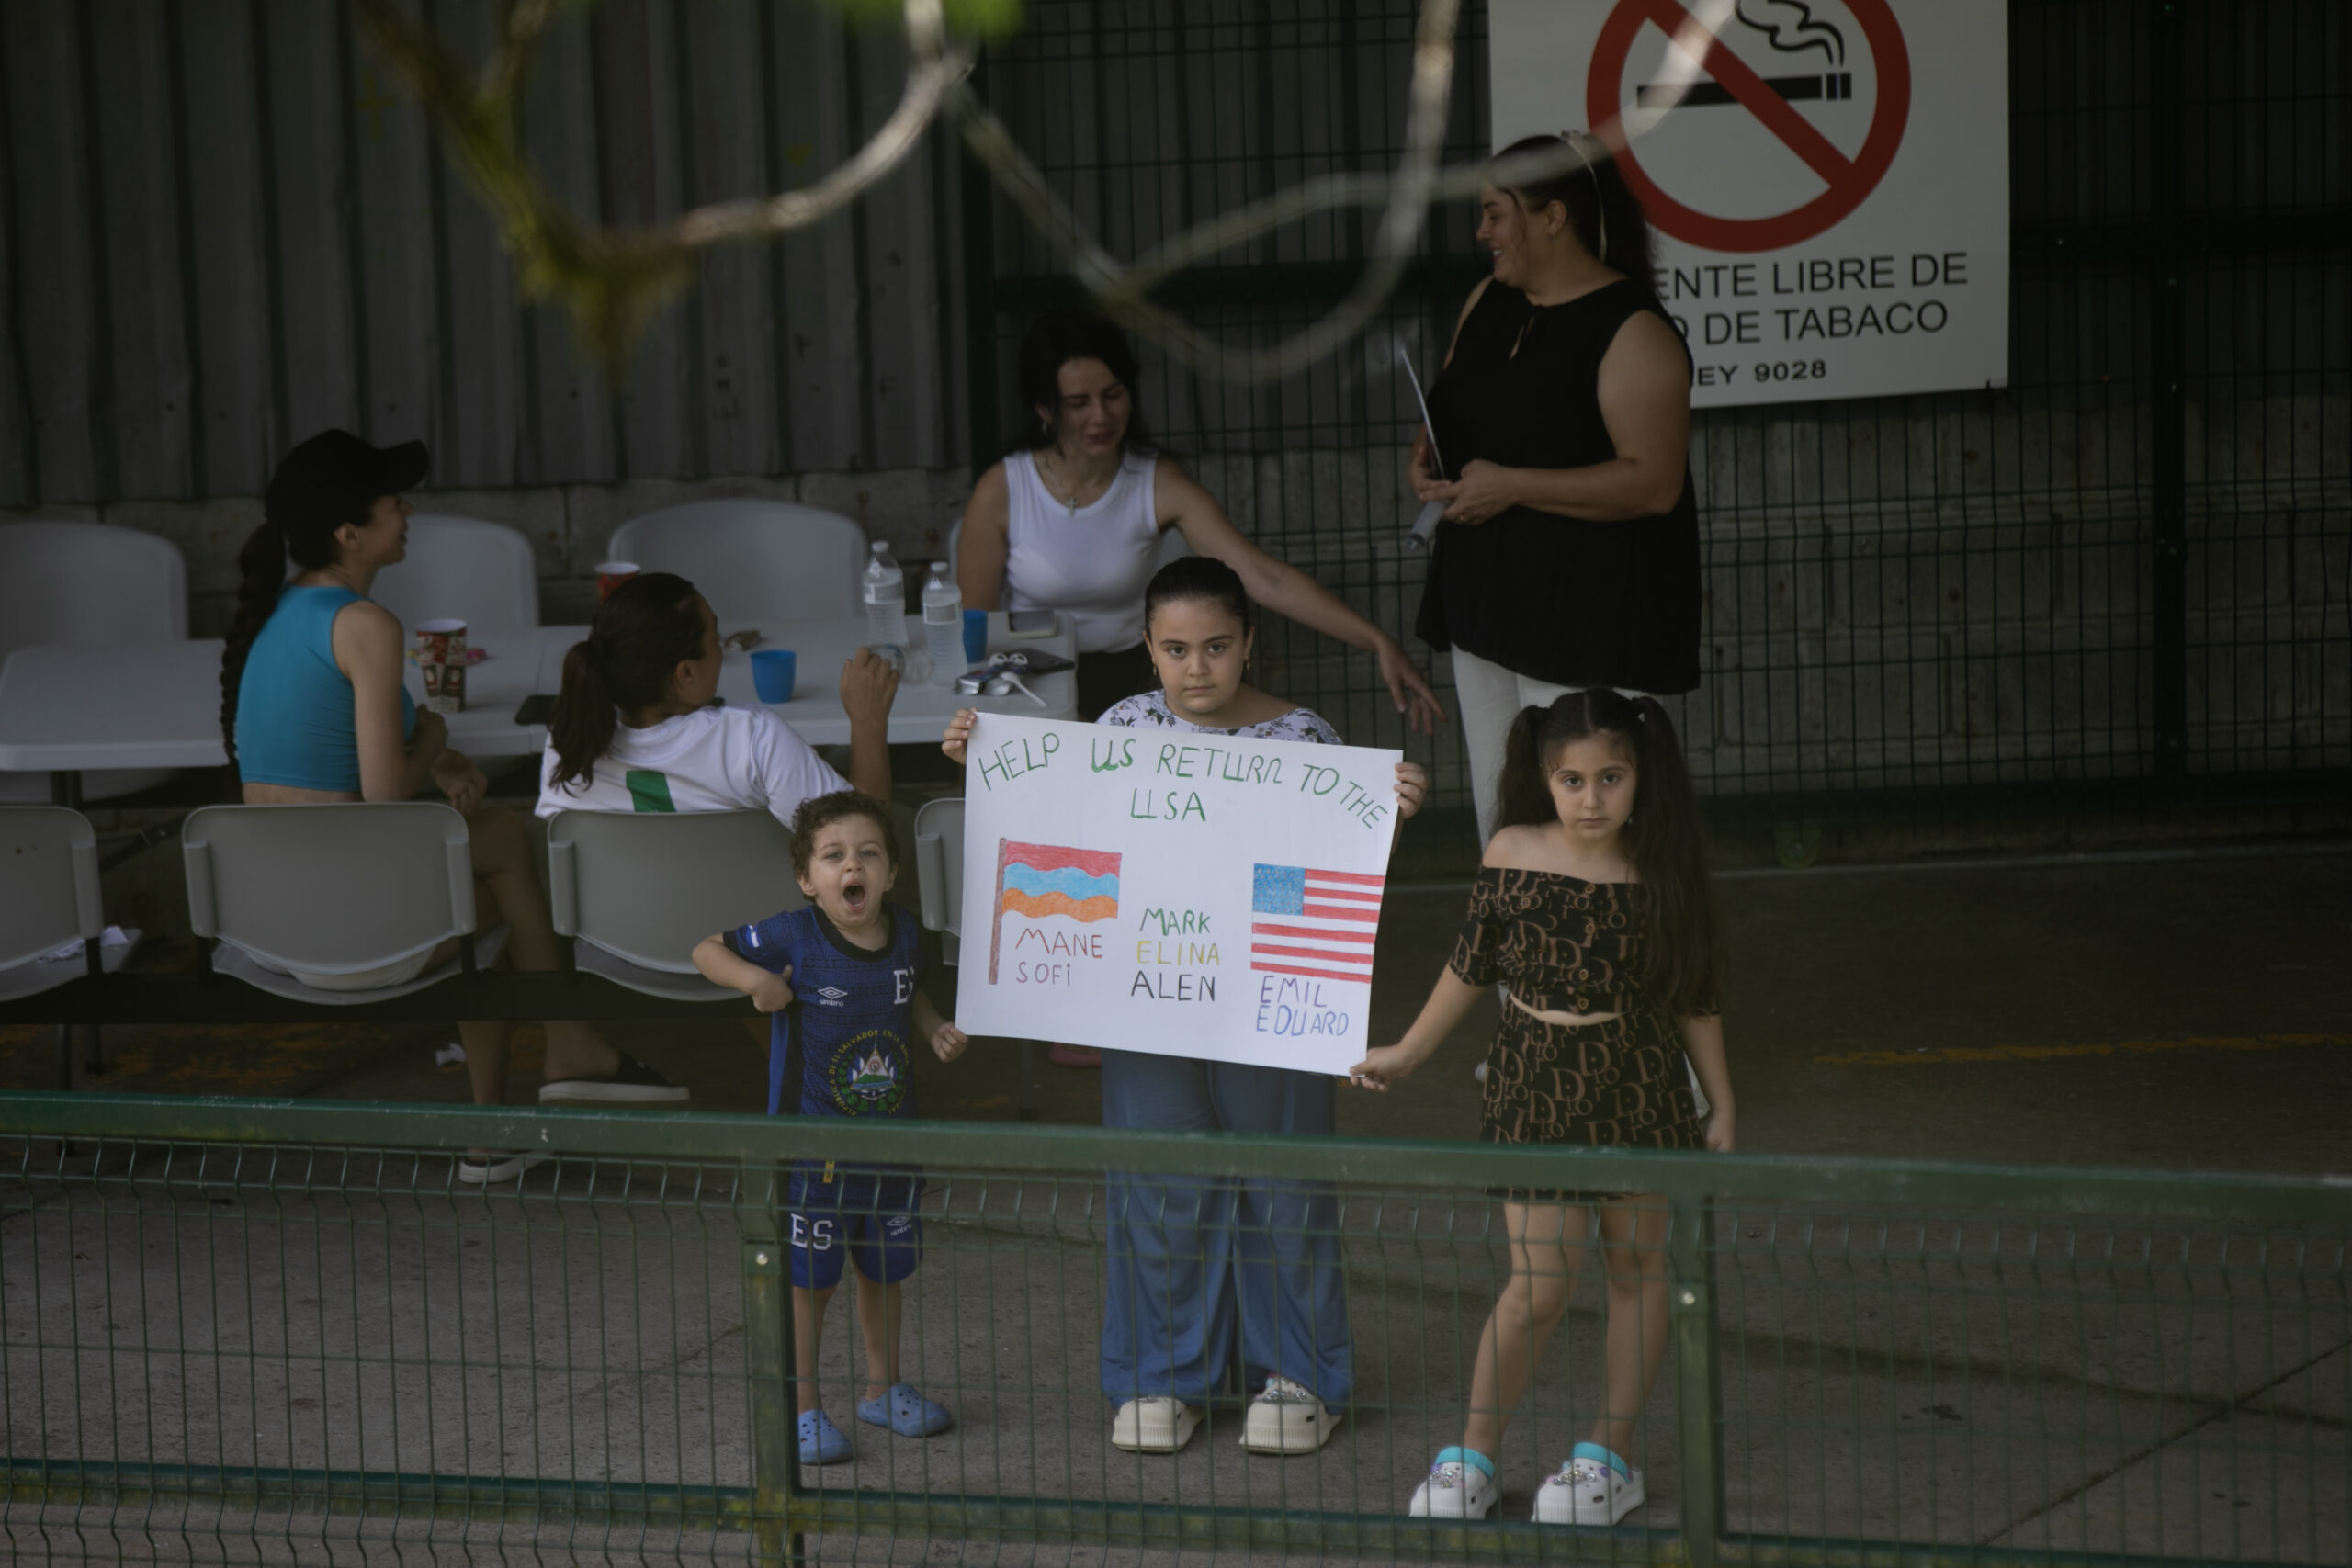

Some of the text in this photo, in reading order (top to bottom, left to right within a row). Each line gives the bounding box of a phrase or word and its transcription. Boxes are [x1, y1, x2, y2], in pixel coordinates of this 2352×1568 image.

[1773, 252, 1895, 295] LIBRE
[1912, 251, 1968, 287] DE
[1705, 310, 1761, 345] DE
[1774, 299, 1948, 341] TABACO
[1754, 359, 1827, 383] 9028
[978, 732, 1060, 791] HELP
[1091, 738, 1136, 773] US
[1300, 763, 1340, 796] TO
[1340, 780, 1388, 829] THE
[1130, 787, 1206, 822] USA
[1139, 908, 1211, 936] MARK
[1015, 928, 1102, 958] MANE
[1136, 940, 1220, 966] ELINA
[1130, 970, 1216, 1002] ALEN
[1260, 975, 1328, 1008] EMIL
[820, 998, 844, 1007] umbro
[1256, 1004, 1350, 1036] EDUARD
[838, 1029, 879, 1055] SALVADOR
[790, 1213, 833, 1251] ES
